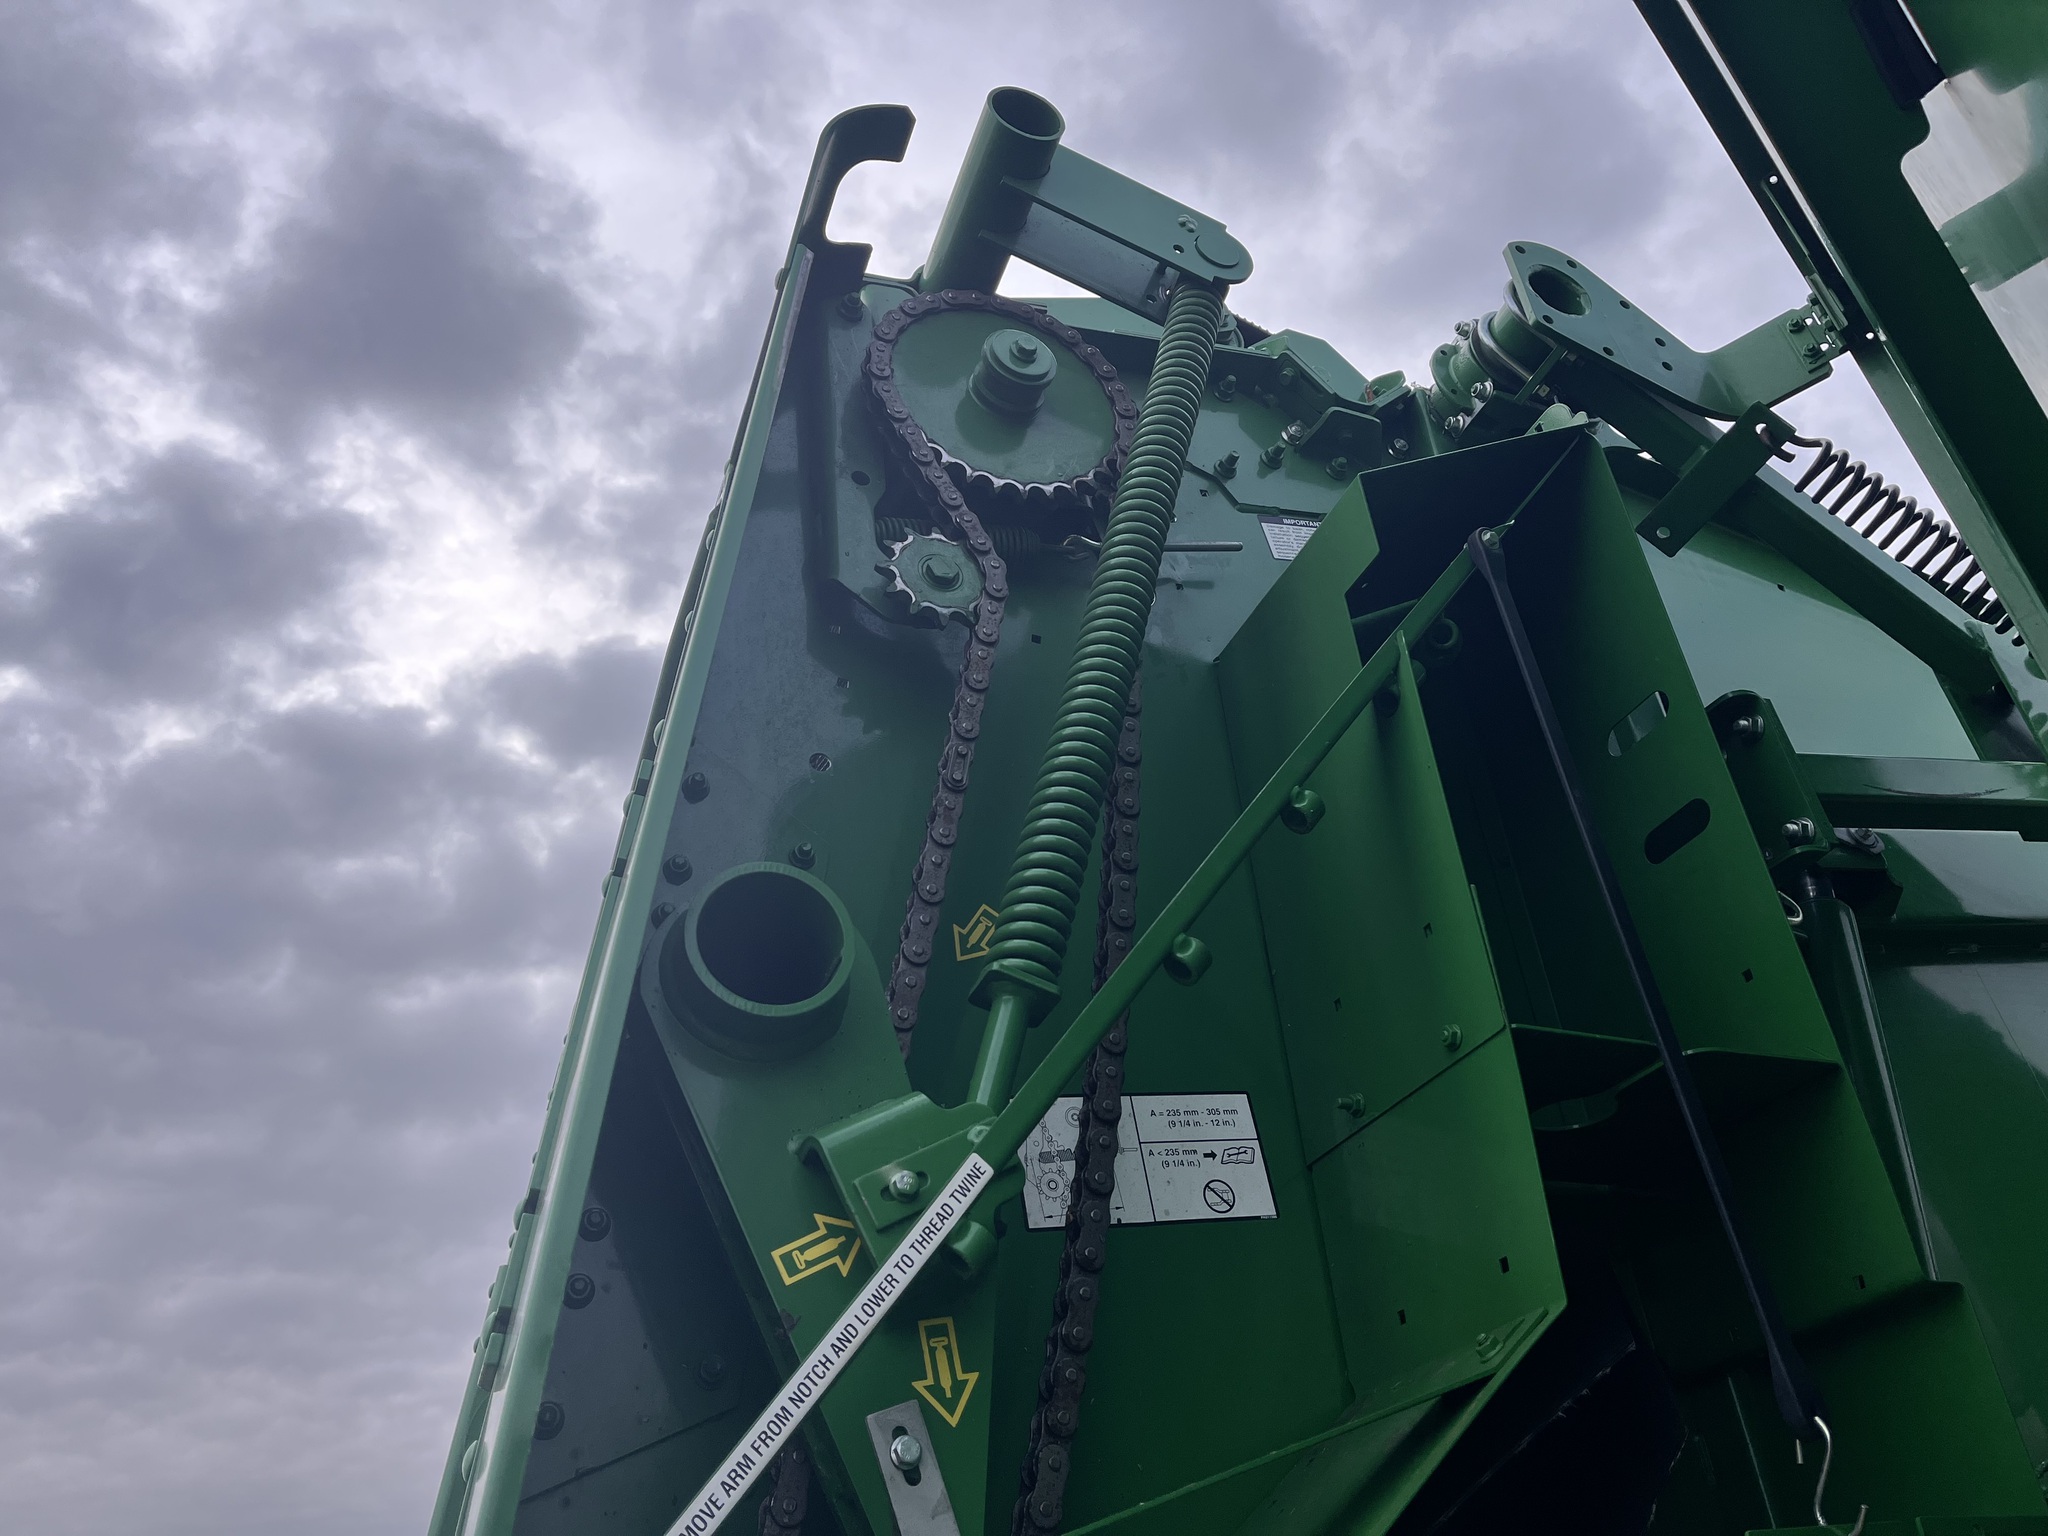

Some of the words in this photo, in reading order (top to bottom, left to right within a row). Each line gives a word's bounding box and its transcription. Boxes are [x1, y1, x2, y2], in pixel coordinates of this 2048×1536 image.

[1150, 1109, 1157, 1117] A
[1166, 1108, 1181, 1117] 235
[1183, 1109, 1199, 1117] mm
[1205, 1108, 1221, 1116] 305
[1168, 1120, 1177, 1129] (9
[1179, 1119, 1191, 1127] 1/4
[1211, 1119, 1221, 1127] 12
[1222, 1119, 1236, 1128] in.)
[1148, 1149, 1155, 1157] A
[1164, 1148, 1180, 1156] 235
[1161, 1160, 1170, 1170] (9
[1173, 1159, 1185, 1167] 1/4
[1187, 1159, 1201, 1168] in.)
[720, 1452, 757, 1499] ARM
[750, 1405, 794, 1458] FROM
[787, 1353, 835, 1410] NOTCH
[829, 1323, 859, 1359] AND
[854, 1273, 900, 1326] LOWER
[893, 1253, 915, 1275] TO
[908, 1202, 955, 1256] THREAD
[948, 1161, 987, 1205] TWINE
